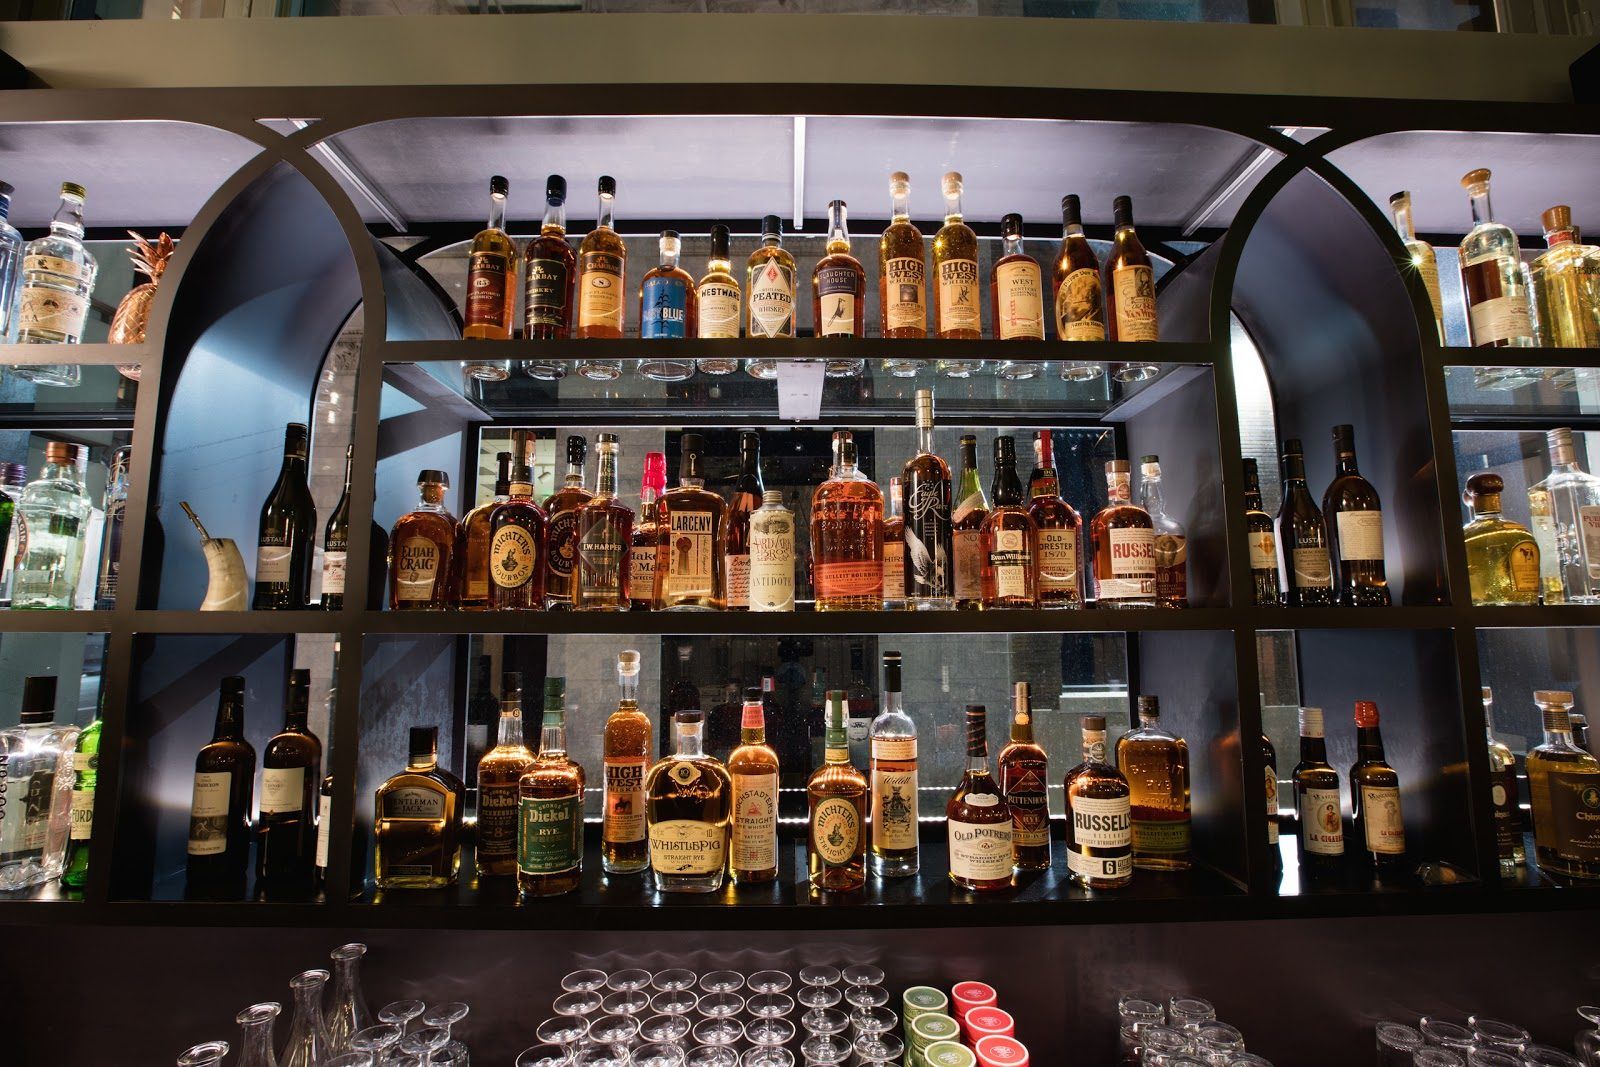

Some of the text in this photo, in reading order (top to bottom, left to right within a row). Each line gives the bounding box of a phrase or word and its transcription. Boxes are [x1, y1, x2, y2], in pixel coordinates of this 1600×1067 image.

[753, 292, 792, 304] PEATED
[662, 308, 684, 320] BLUE
[909, 480, 941, 512] Eagle
[672, 516, 711, 532] LARCENY
[402, 546, 434, 558] ELIJAH
[400, 558, 434, 571] CRAIG
[494, 564, 528, 580] BOURBON
[752, 576, 792, 587] ANTIDOTE
[1142, 581, 1152, 593] 10
[482, 794, 518, 807] Dickel
[1008, 795, 1047, 804] RITTENHOUS
[530, 808, 570, 822] Dickel
[954, 830, 973, 840] OLD
[651, 838, 720, 852] WHISTLEPIG
[818, 835, 846, 856] STRAIGHT
[1106, 862, 1114, 874] 6
